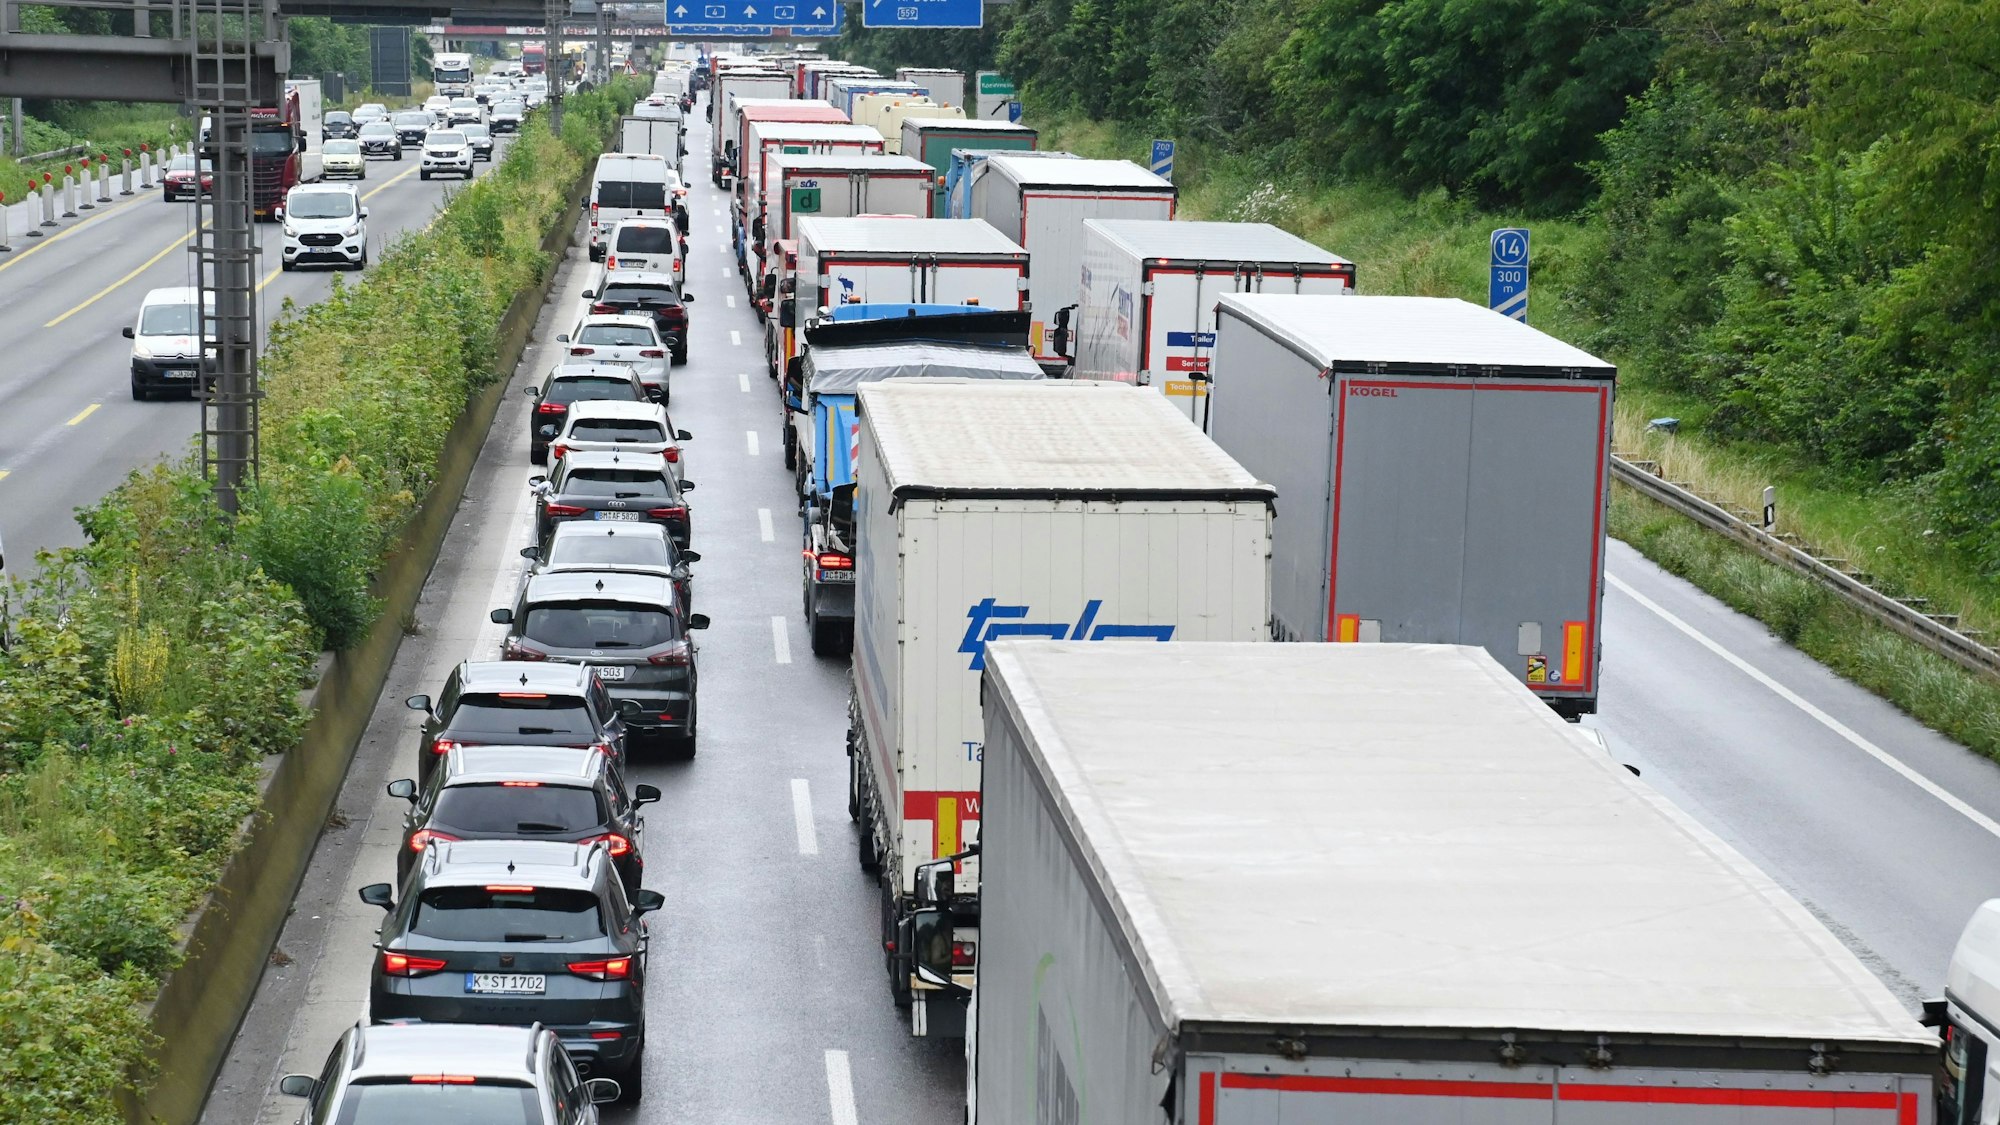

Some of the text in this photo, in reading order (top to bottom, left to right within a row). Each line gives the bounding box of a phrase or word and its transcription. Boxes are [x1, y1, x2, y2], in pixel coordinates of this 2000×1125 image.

[900, 9, 915, 17] 559
[1156, 142, 1170, 151] 200
[801, 191, 812, 209] d
[1500, 238, 1520, 257] 14
[1497, 270, 1521, 283] 300
[1503, 285, 1514, 293] m
[1191, 335, 1214, 343] Tailer
[1350, 387, 1398, 398] KÖGEL
[612, 512, 621, 520] AF
[621, 512, 638, 520] 5820
[825, 571, 834, 579] AC
[604, 667, 621, 677] 503
[474, 975, 543, 989] K ST 1702
